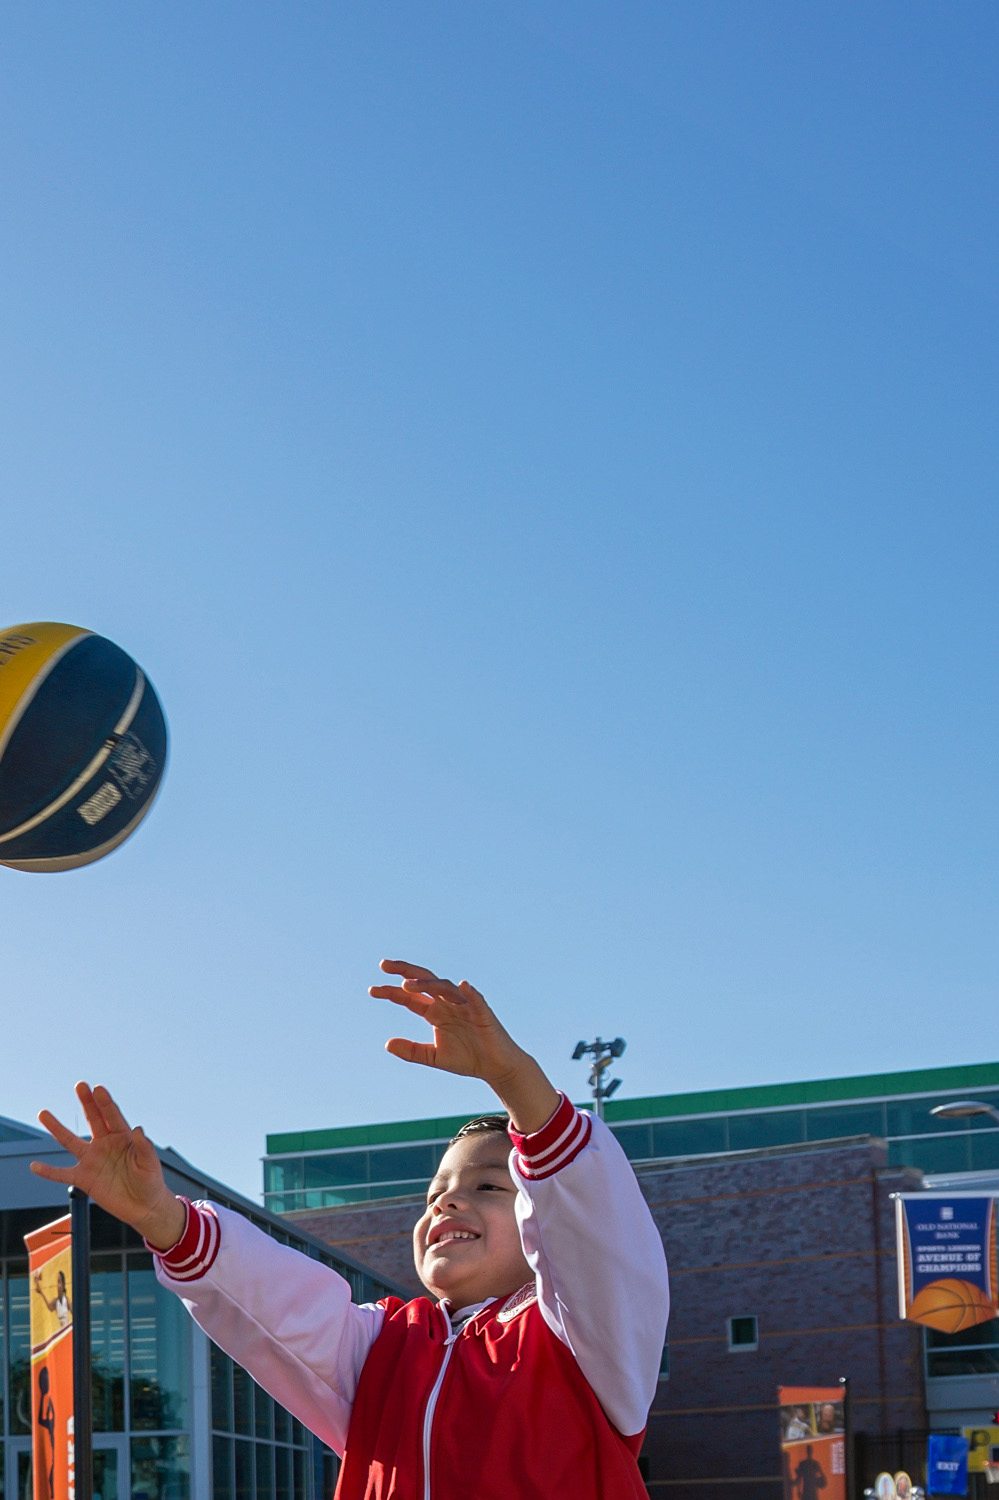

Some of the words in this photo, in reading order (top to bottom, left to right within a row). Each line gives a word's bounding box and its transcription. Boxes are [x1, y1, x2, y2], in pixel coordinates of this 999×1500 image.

[916, 1223, 936, 1231] OLD
[937, 1222, 979, 1231] NATIONAL
[918, 1253, 963, 1262] AVENUE
[965, 1252, 981, 1261] OF
[917, 1263, 982, 1273] CHAMPIONS
[936, 1461, 960, 1472] EXIT
